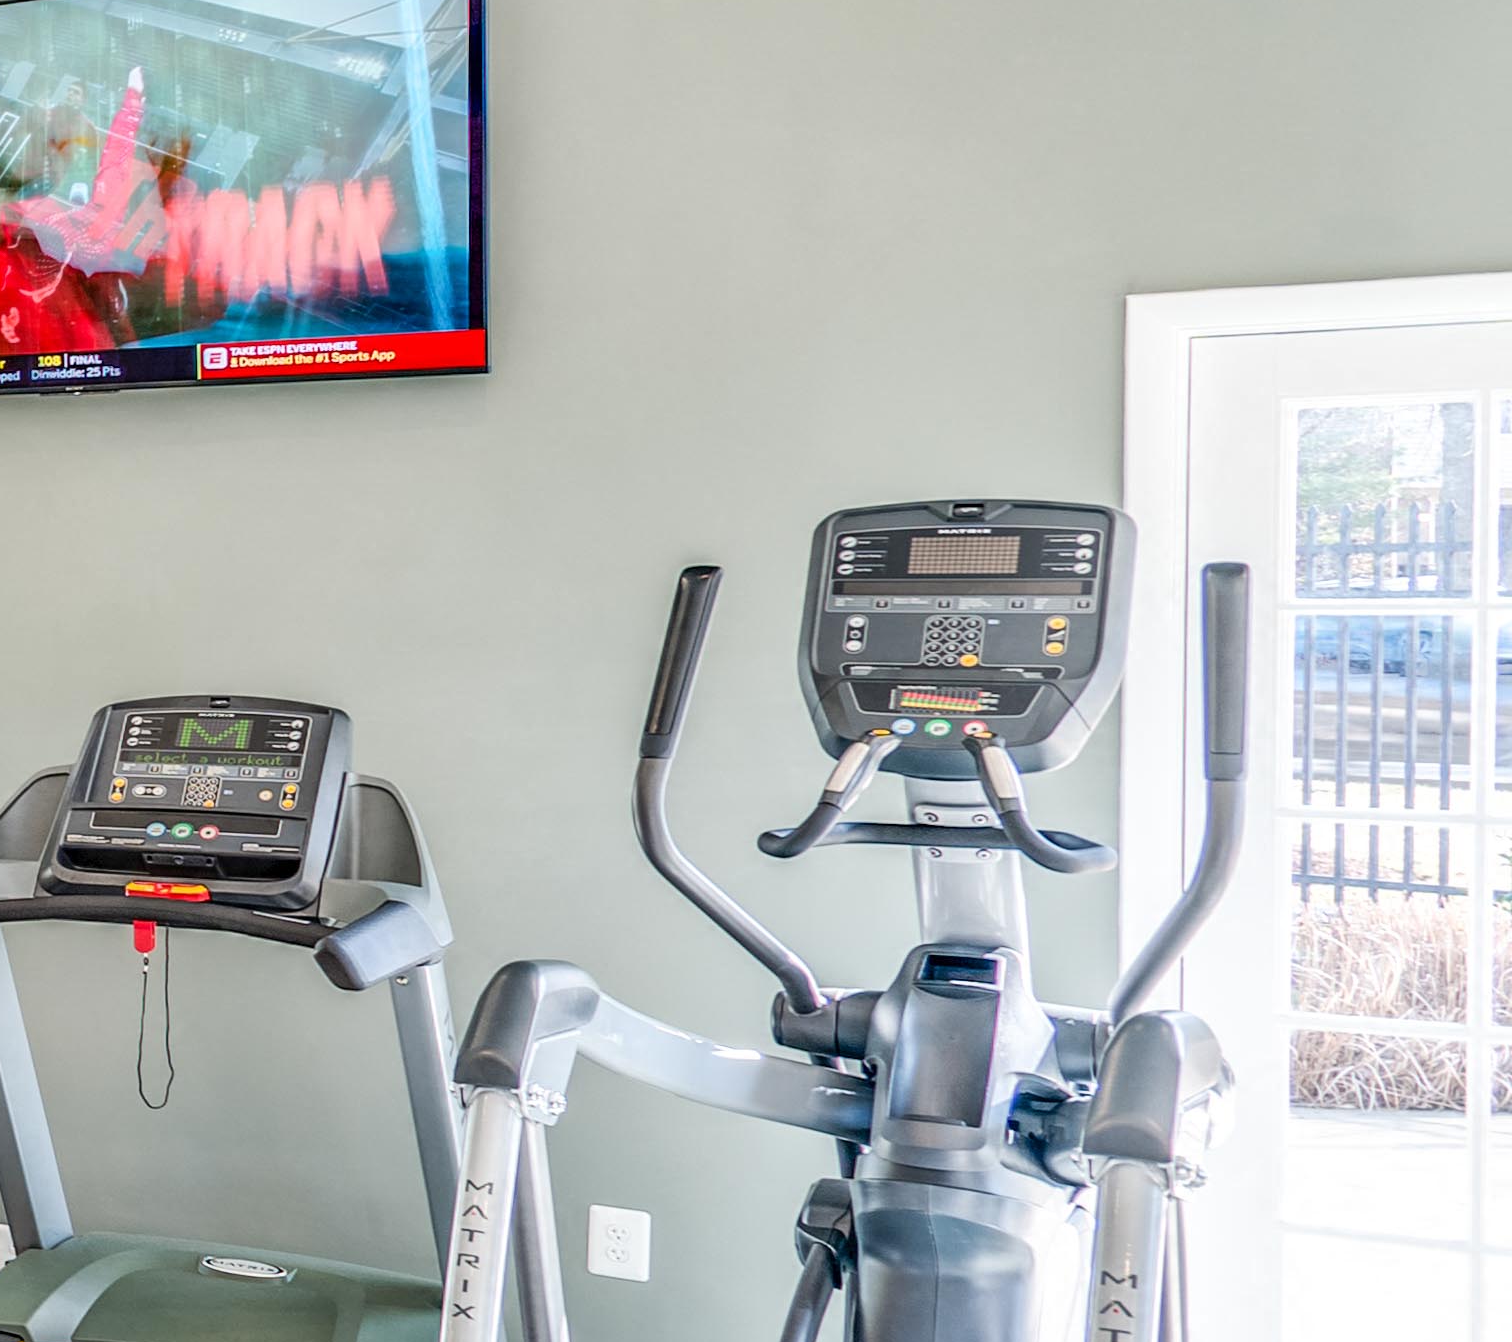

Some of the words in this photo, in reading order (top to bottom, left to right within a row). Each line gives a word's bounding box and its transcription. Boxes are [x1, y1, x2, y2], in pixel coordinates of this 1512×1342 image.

[230, 346, 256, 356] TAKE
[257, 345, 285, 355] ESPN
[286, 341, 357, 353] EVERYWHERE
[38, 355, 61, 367] 108
[70, 354, 102, 365] FINAL
[239, 354, 293, 367] Download
[294, 354, 314, 364] the
[332, 351, 369, 364] Sports
[371, 350, 396, 363] App
[217, 754, 285, 766] workout
[452, 1178, 494, 1320] MATRIX
